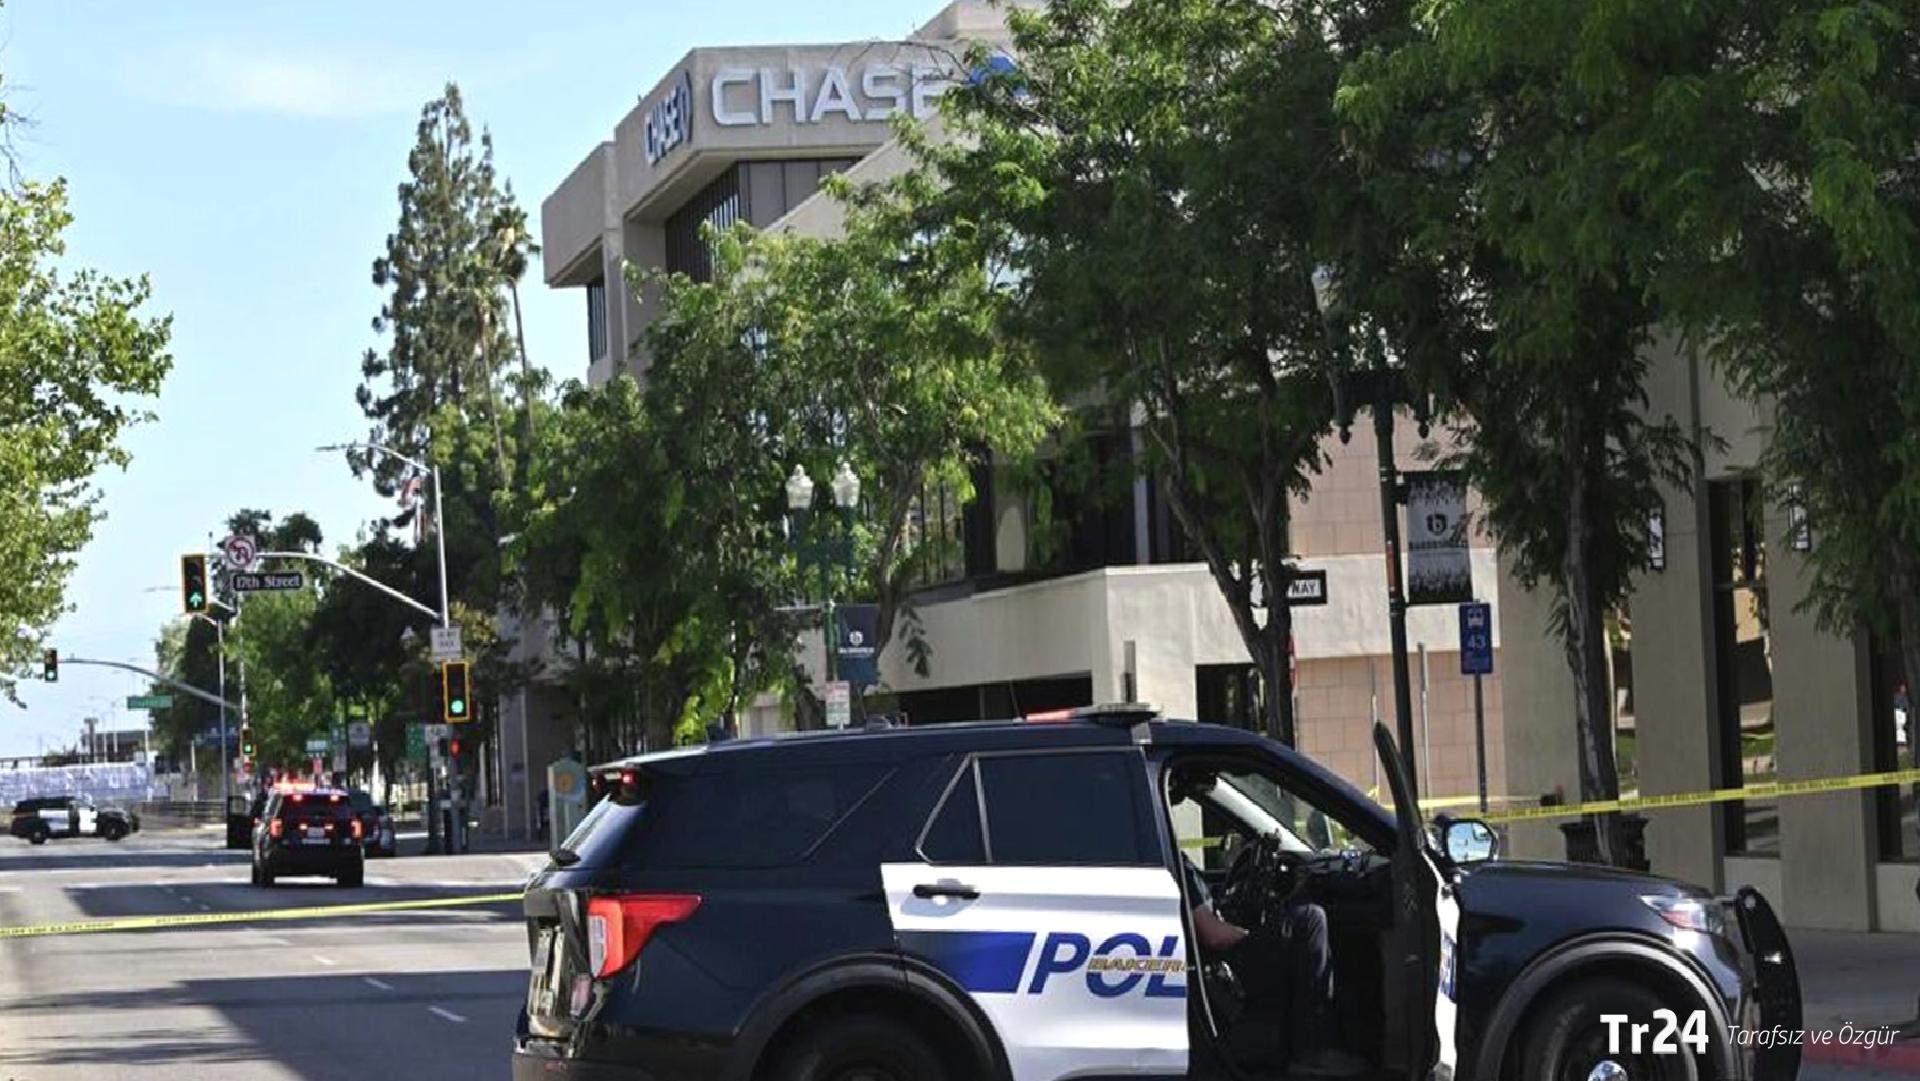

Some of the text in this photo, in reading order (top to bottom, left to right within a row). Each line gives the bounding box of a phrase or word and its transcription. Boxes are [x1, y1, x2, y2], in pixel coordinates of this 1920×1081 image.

[711, 61, 953, 126] CHASE
[644, 85, 680, 165] CHASE
[263, 574, 300, 588] Street
[1467, 634, 1486, 649] 43
[1088, 958, 1187, 972] BAKER
